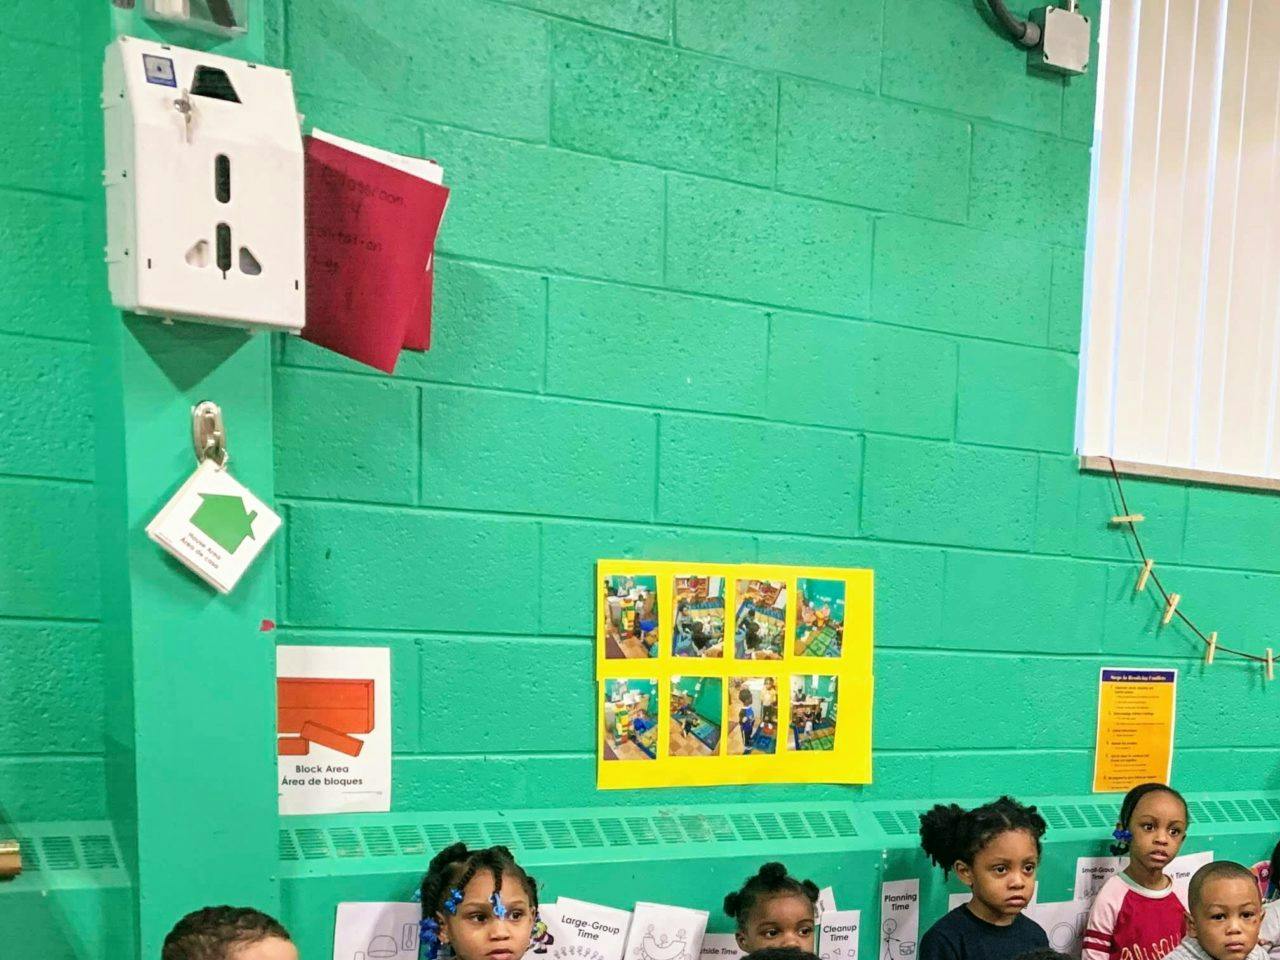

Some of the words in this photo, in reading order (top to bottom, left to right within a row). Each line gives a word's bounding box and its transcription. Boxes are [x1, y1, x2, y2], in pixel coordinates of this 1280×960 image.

[295, 765, 322, 773] Block
[325, 765, 349, 773] Area
[281, 775, 305, 786] Área
[308, 777, 321, 786] de
[324, 777, 363, 787] bloques
[1175, 871, 1191, 879] Time
[884, 893, 917, 903] Planning
[891, 902, 910, 912] Time
[561, 915, 620, 936] Large-Group
[823, 925, 857, 934] Cleanup
[577, 928, 600, 942] Time
[830, 934, 849, 942] Time
[721, 948, 738, 956] Time
